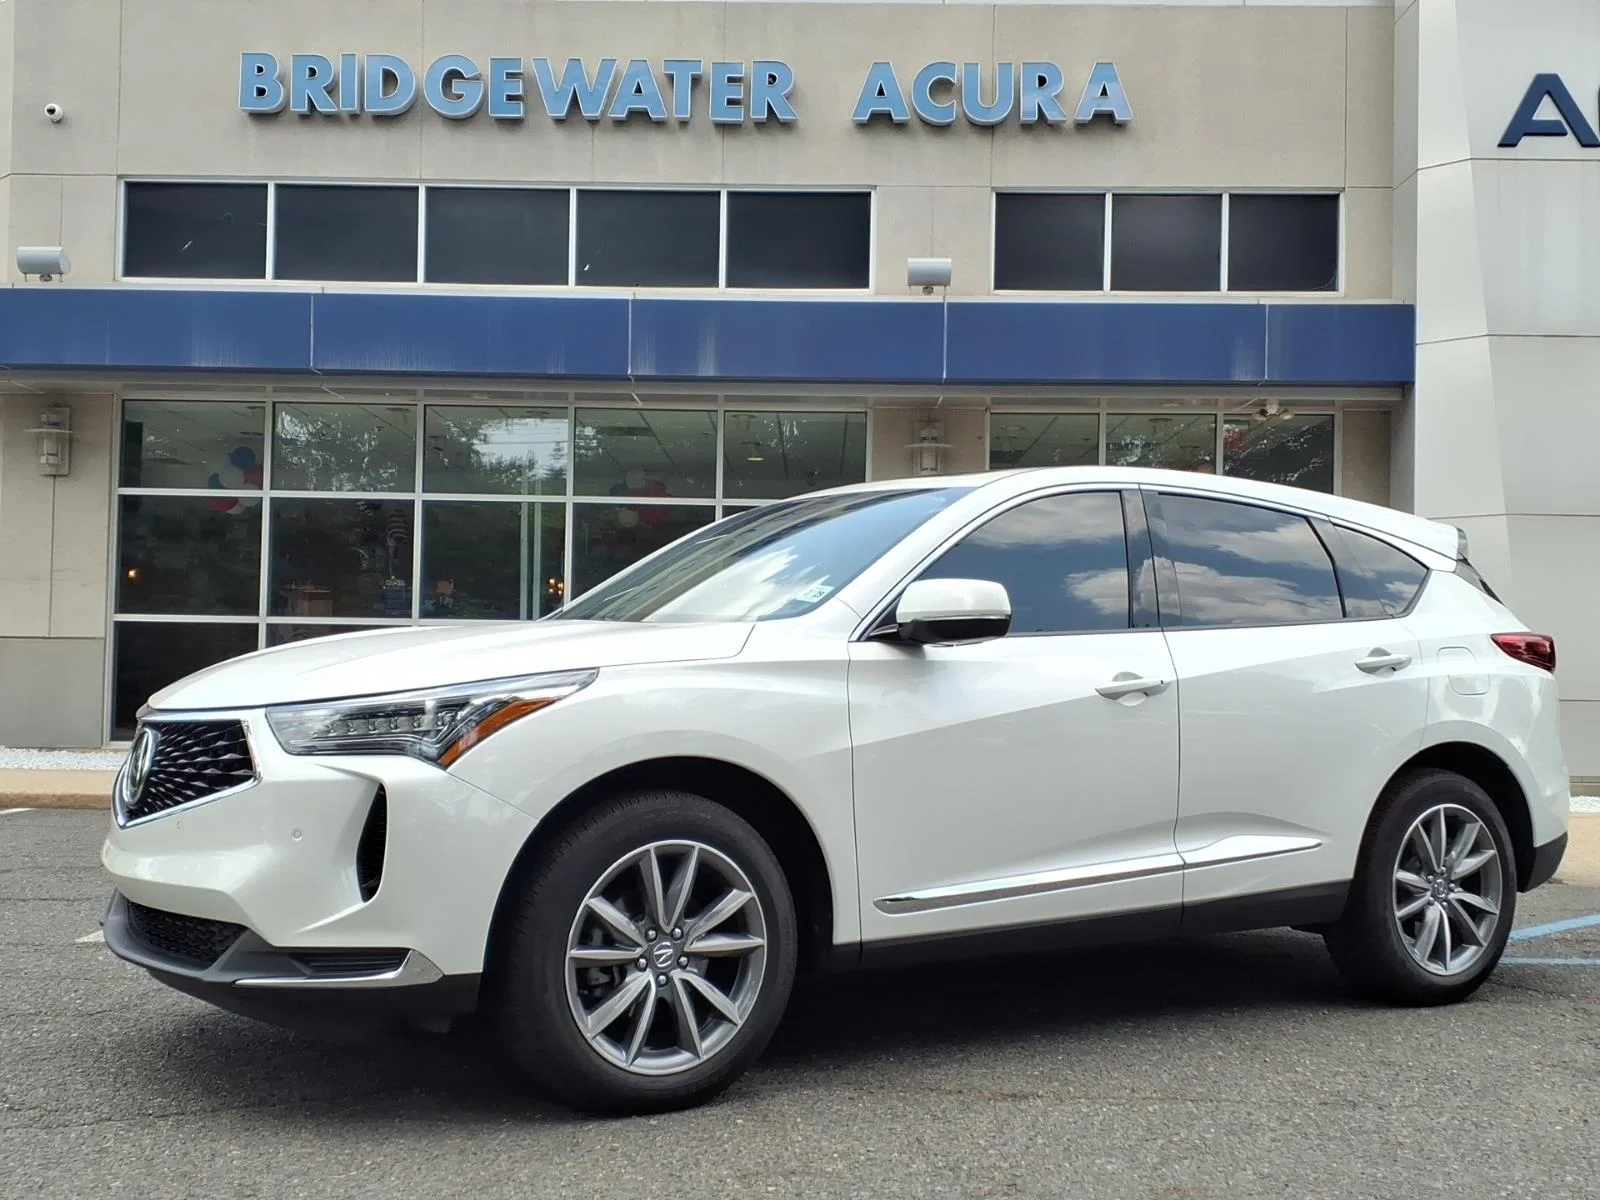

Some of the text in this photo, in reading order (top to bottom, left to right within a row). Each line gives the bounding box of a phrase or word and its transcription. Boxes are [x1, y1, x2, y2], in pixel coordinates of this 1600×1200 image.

[238, 51, 1135, 126] BRIDGEWATER ACURA
[1497, 73, 1600, 148] A
